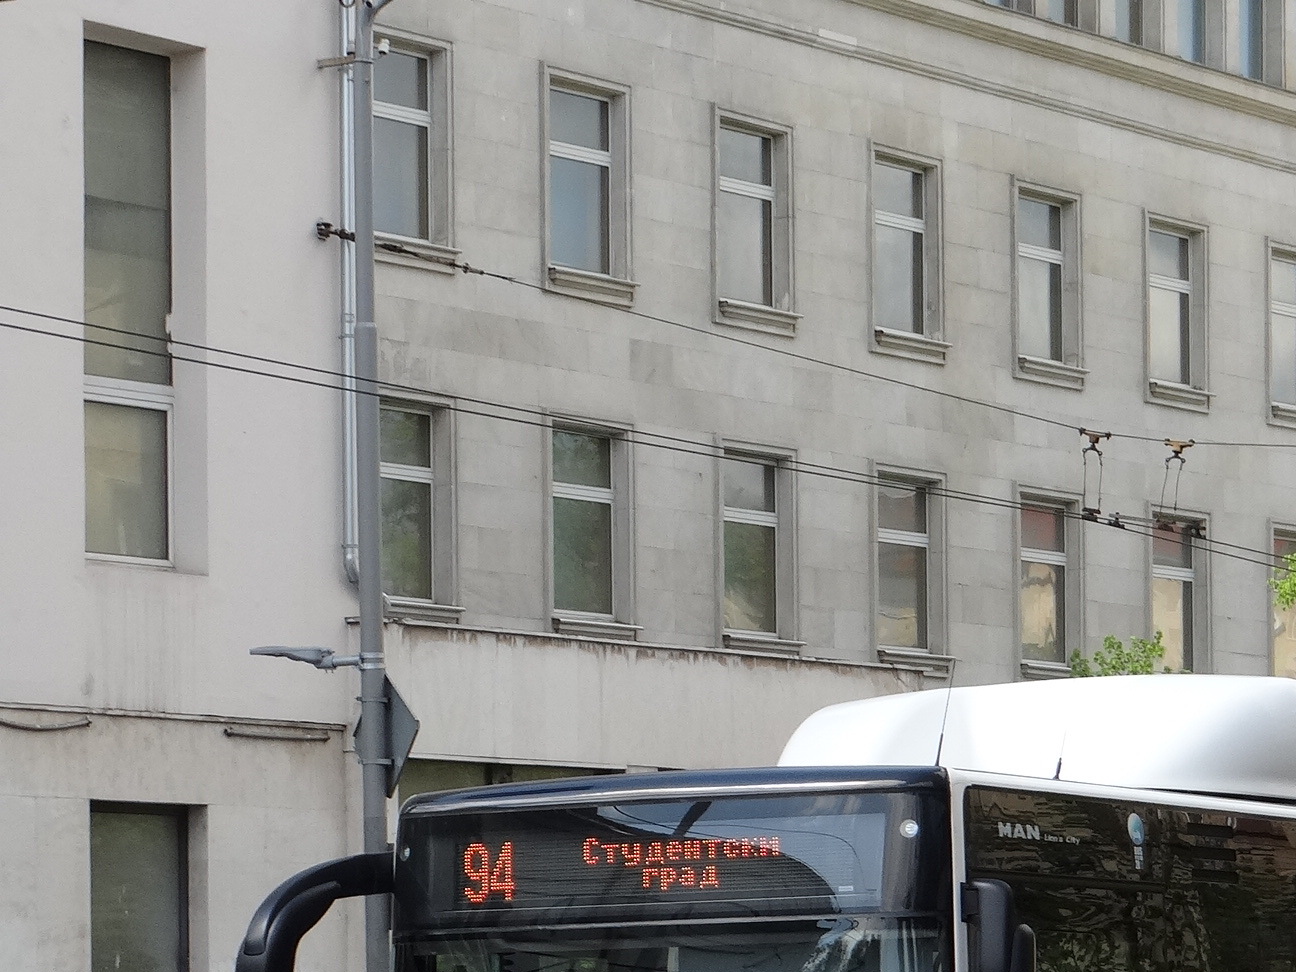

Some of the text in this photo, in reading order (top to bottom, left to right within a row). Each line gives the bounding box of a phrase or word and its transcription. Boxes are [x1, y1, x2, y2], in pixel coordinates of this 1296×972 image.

[998, 821, 1040, 841] MAN
[464, 841, 516, 903] 94
[642, 865, 719, 891] град
